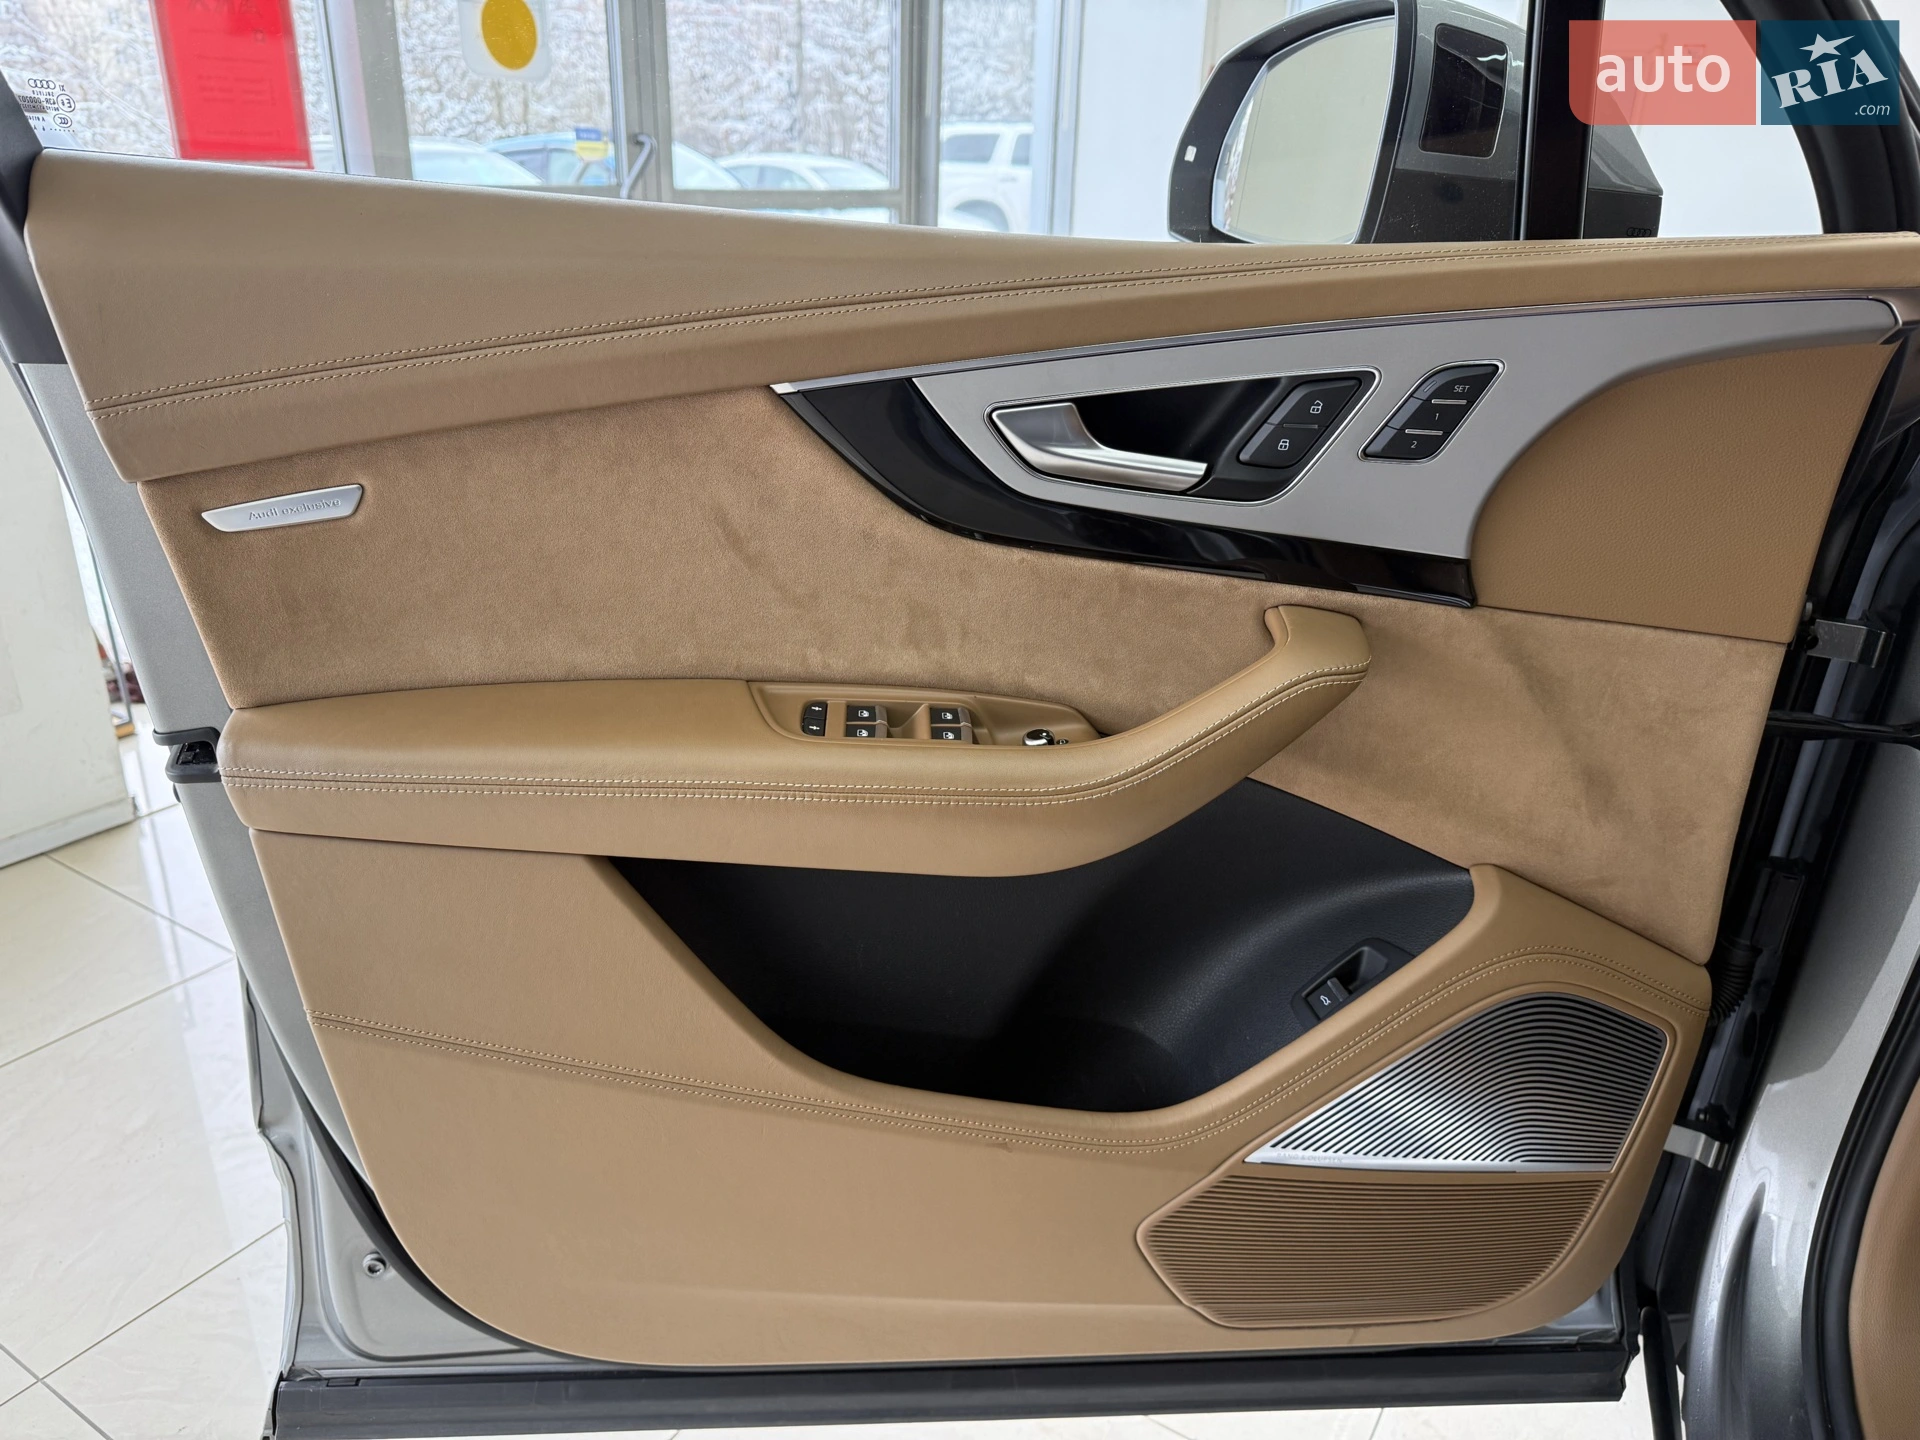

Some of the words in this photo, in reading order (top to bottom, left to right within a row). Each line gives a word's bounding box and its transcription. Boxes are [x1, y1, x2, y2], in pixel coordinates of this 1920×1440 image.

[1453, 385, 1470, 393] SET
[1410, 440, 1418, 449] 2
[248, 507, 279, 521] Audi
[281, 498, 342, 516] exclusive
